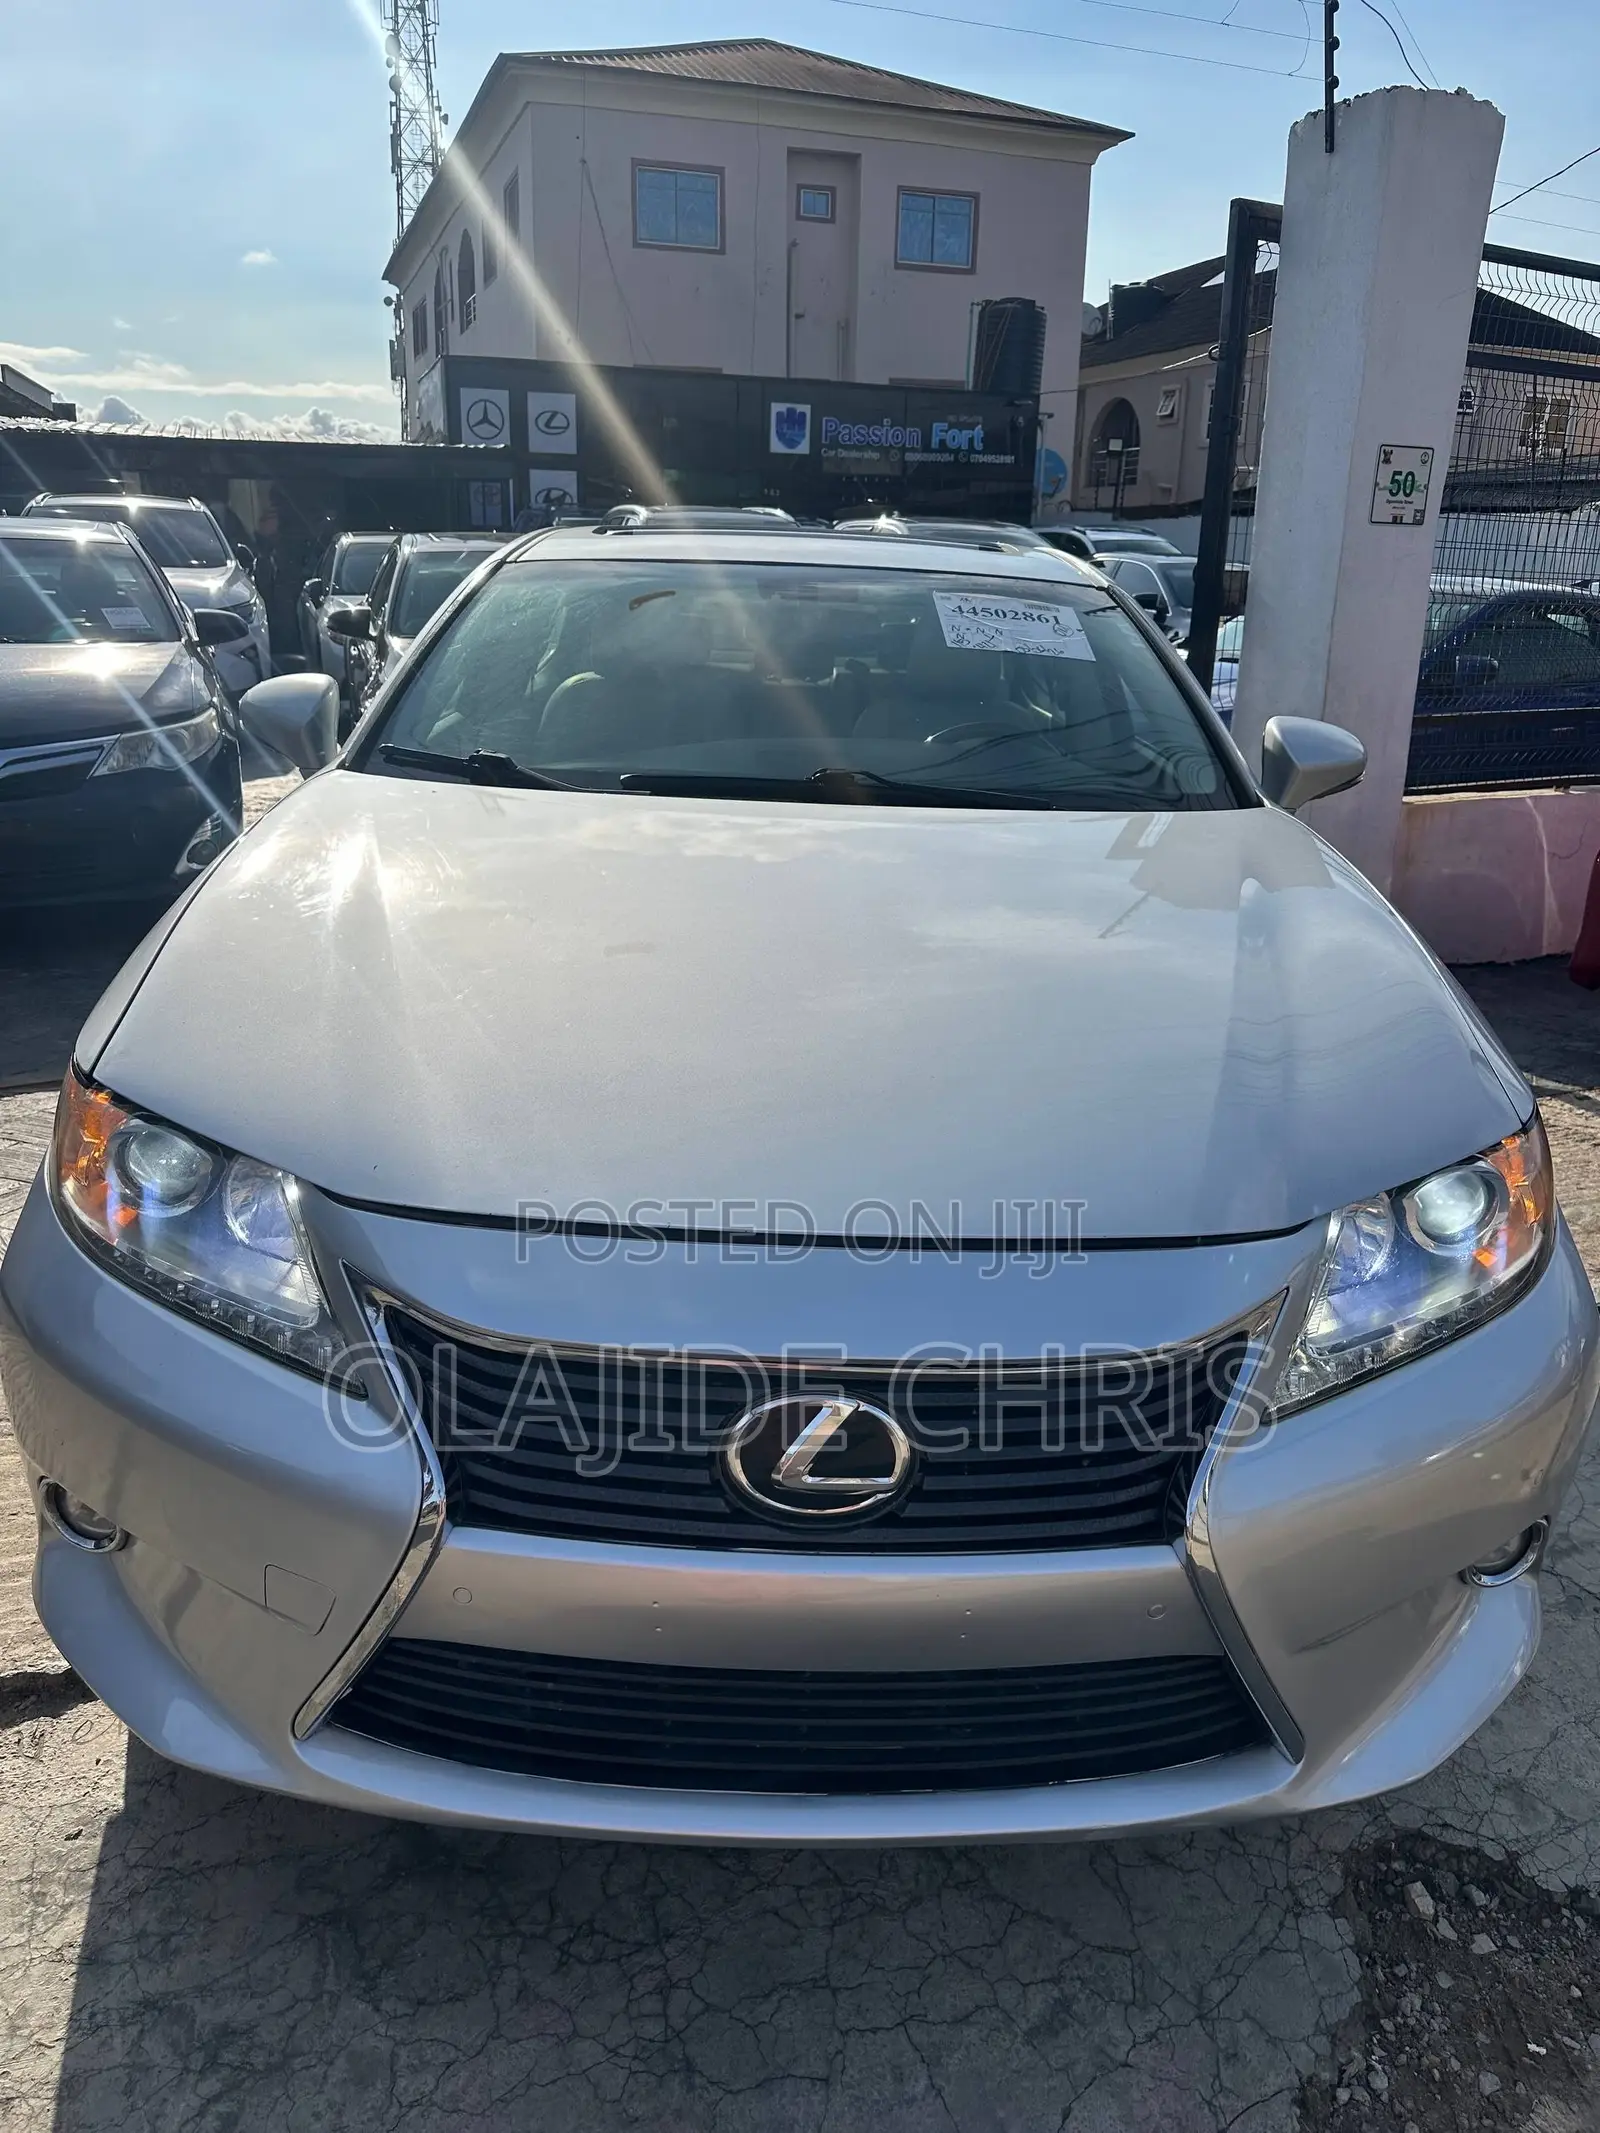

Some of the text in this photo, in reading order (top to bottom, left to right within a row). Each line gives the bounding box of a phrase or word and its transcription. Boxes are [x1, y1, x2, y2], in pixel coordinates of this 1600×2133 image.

[821, 417, 984, 450] Passion Fort
[1388, 470, 1416, 497] 50
[951, 604, 1061, 625] 44502861
